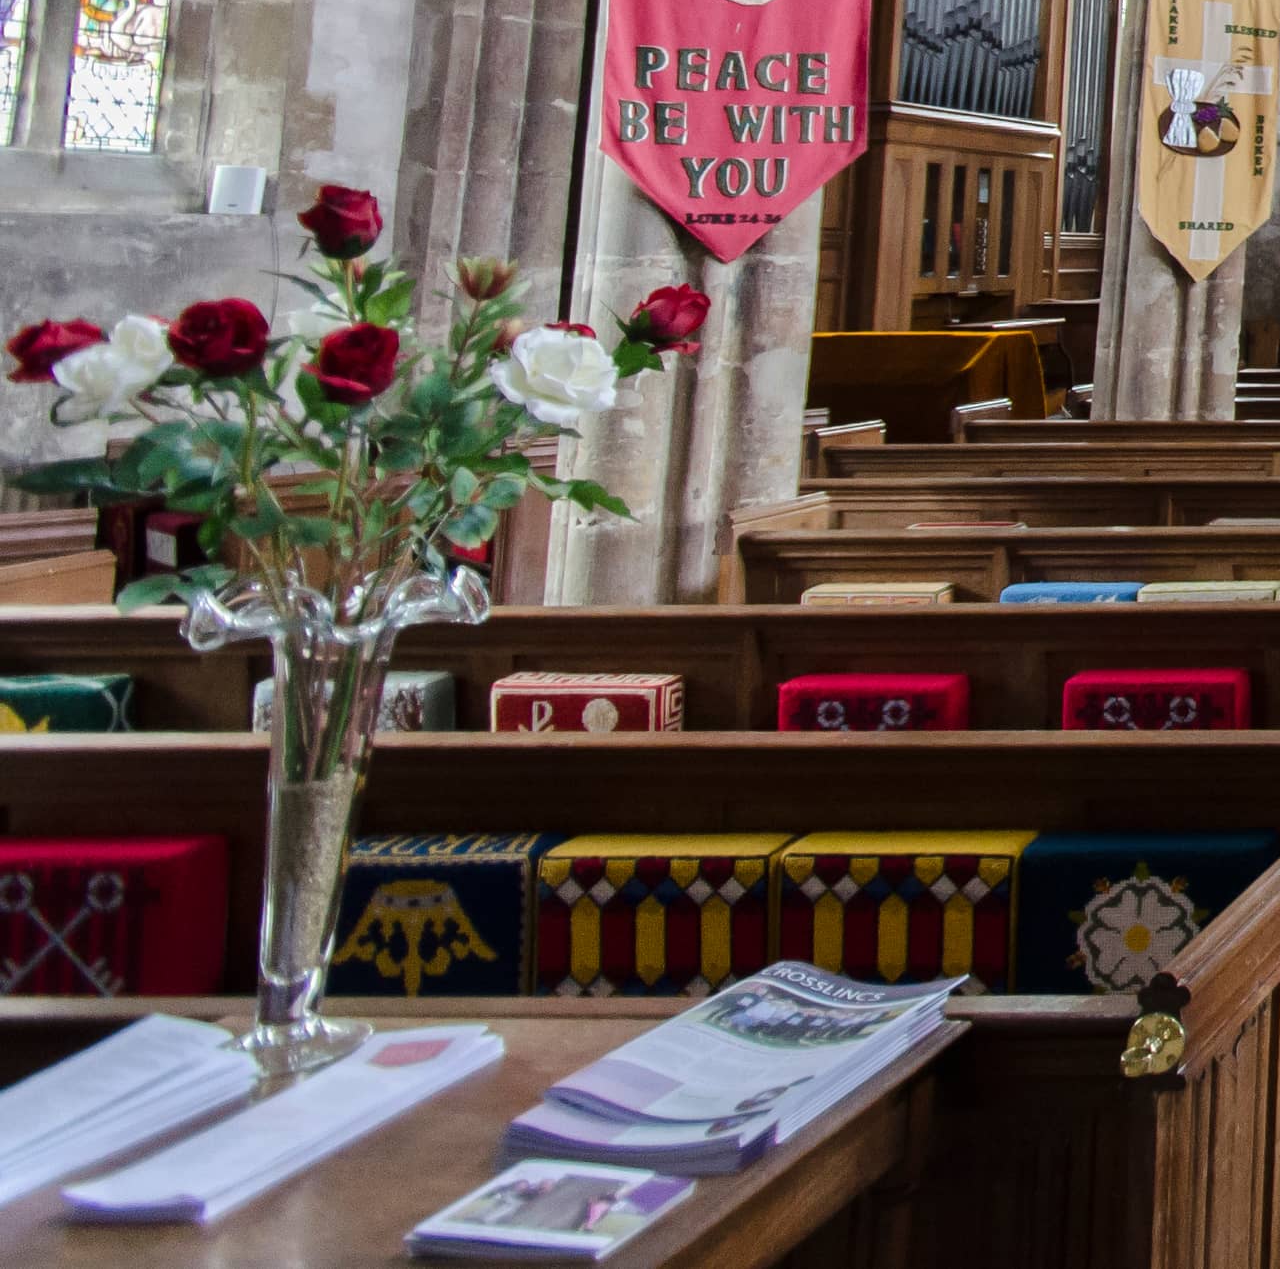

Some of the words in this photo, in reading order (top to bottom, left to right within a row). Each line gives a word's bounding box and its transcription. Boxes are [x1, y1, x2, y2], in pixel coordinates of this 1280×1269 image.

[1224, 24, 1278, 39] BLESSED
[634, 44, 829, 95] PEACE
[618, 99, 688, 146] BE
[725, 104, 855, 144] WITH
[681, 156, 789, 199] YOU
[685, 213, 736, 225] LUKE
[1178, 221, 1234, 231] SHARED
[761, 967, 886, 1002] CROSSLINCS
